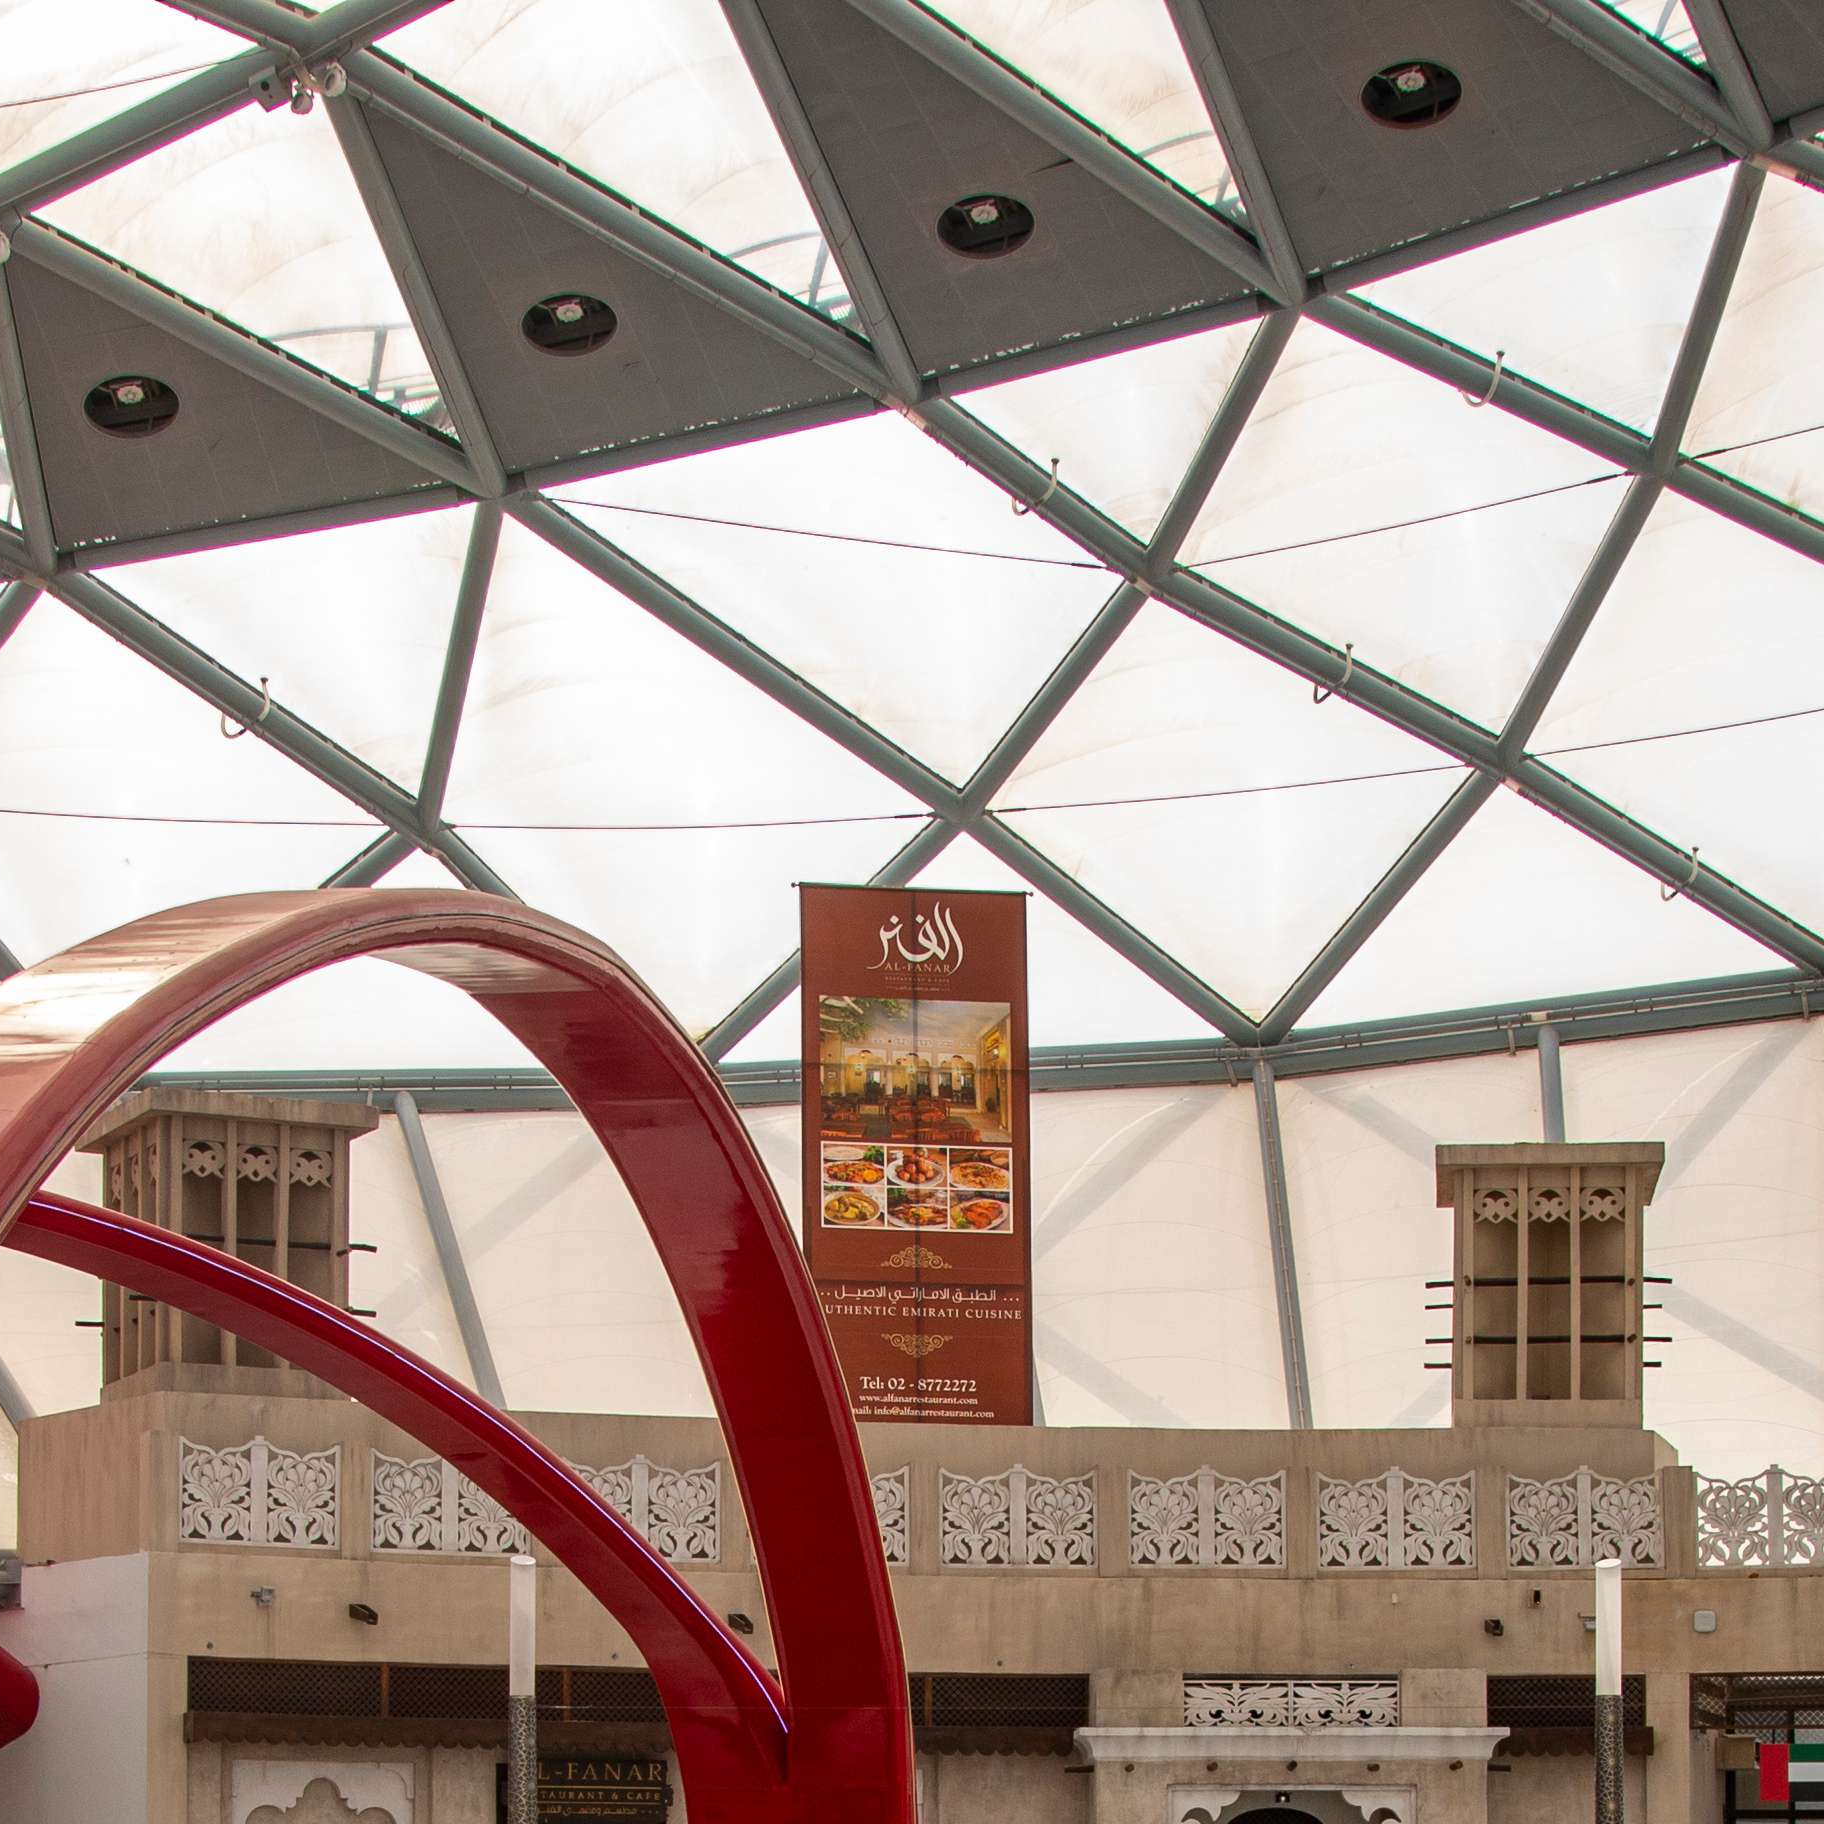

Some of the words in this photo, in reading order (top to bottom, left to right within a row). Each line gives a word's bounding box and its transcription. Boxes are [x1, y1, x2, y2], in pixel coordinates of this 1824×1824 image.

[866, 901, 964, 976] الفنر
[884, 962, 950, 973] AL-FANAR
[826, 1304, 897, 1317] UTHENTIC
[902, 1308, 959, 1319] EMIRATI
[965, 1309, 1022, 1320] CUISINE
[860, 1376, 884, 1390] Tel:
[887, 1378, 906, 1391] 02
[917, 1379, 977, 1392] 8772272
[537, 1761, 663, 1782] L-FANAR
[540, 1790, 605, 1801] TAURANT
[626, 1791, 662, 1801] CAFE
